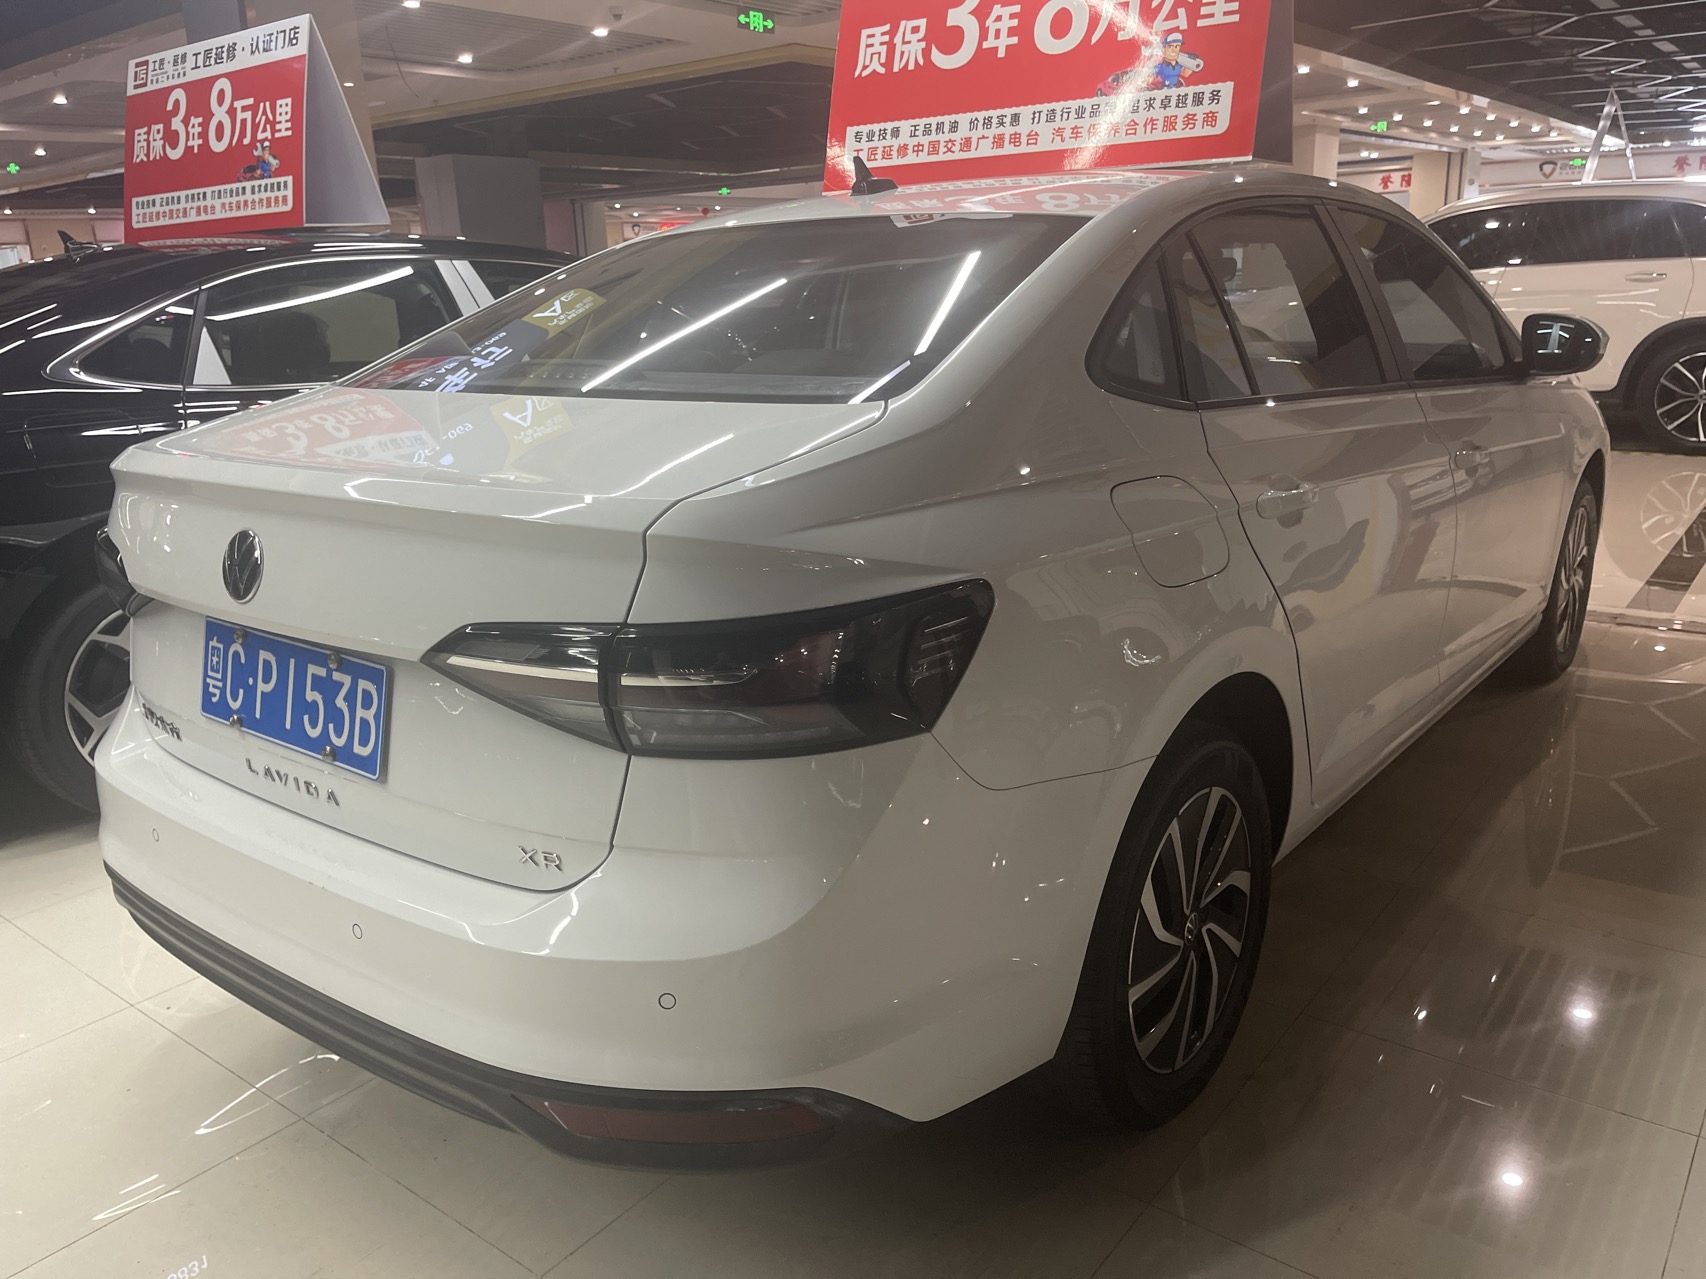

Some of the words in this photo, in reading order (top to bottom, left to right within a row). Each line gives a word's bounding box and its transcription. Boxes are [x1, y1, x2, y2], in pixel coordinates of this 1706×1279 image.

[133, 78, 292, 164] 质保3年8万公里
[854, 127, 901, 144] 专业技师
[909, 120, 959, 138] 正品机油
[969, 113, 1021, 131] 价格实惠
[1031, 101, 1115, 124] 打造行业品
[245, 757, 340, 807] LAVIDA
[518, 845, 563, 872] XR
